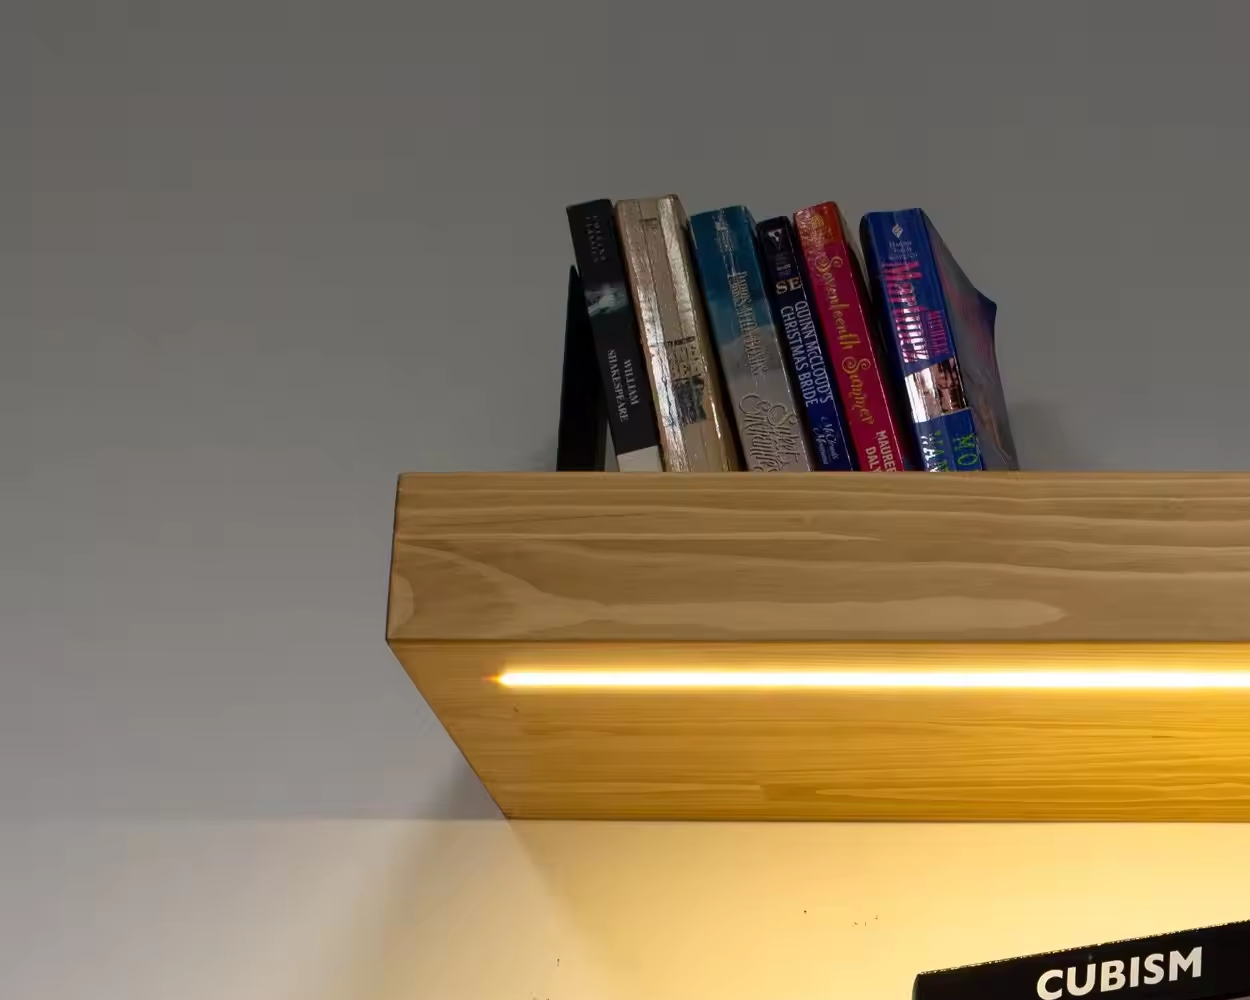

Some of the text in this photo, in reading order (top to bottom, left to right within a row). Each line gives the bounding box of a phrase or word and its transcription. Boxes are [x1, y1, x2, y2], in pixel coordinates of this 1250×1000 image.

[775, 277, 802, 295] SE
[795, 300, 817, 341] QUINN
[815, 254, 875, 425] Seventeenth Summer
[623, 359, 640, 406] WILLIAM
[781, 305, 809, 372] CHRISTMAS
[798, 371, 819, 408] BRIDE
[607, 348, 629, 423] SHAKESPEARE
[1036, 946, 1203, 1000] CUBISM
